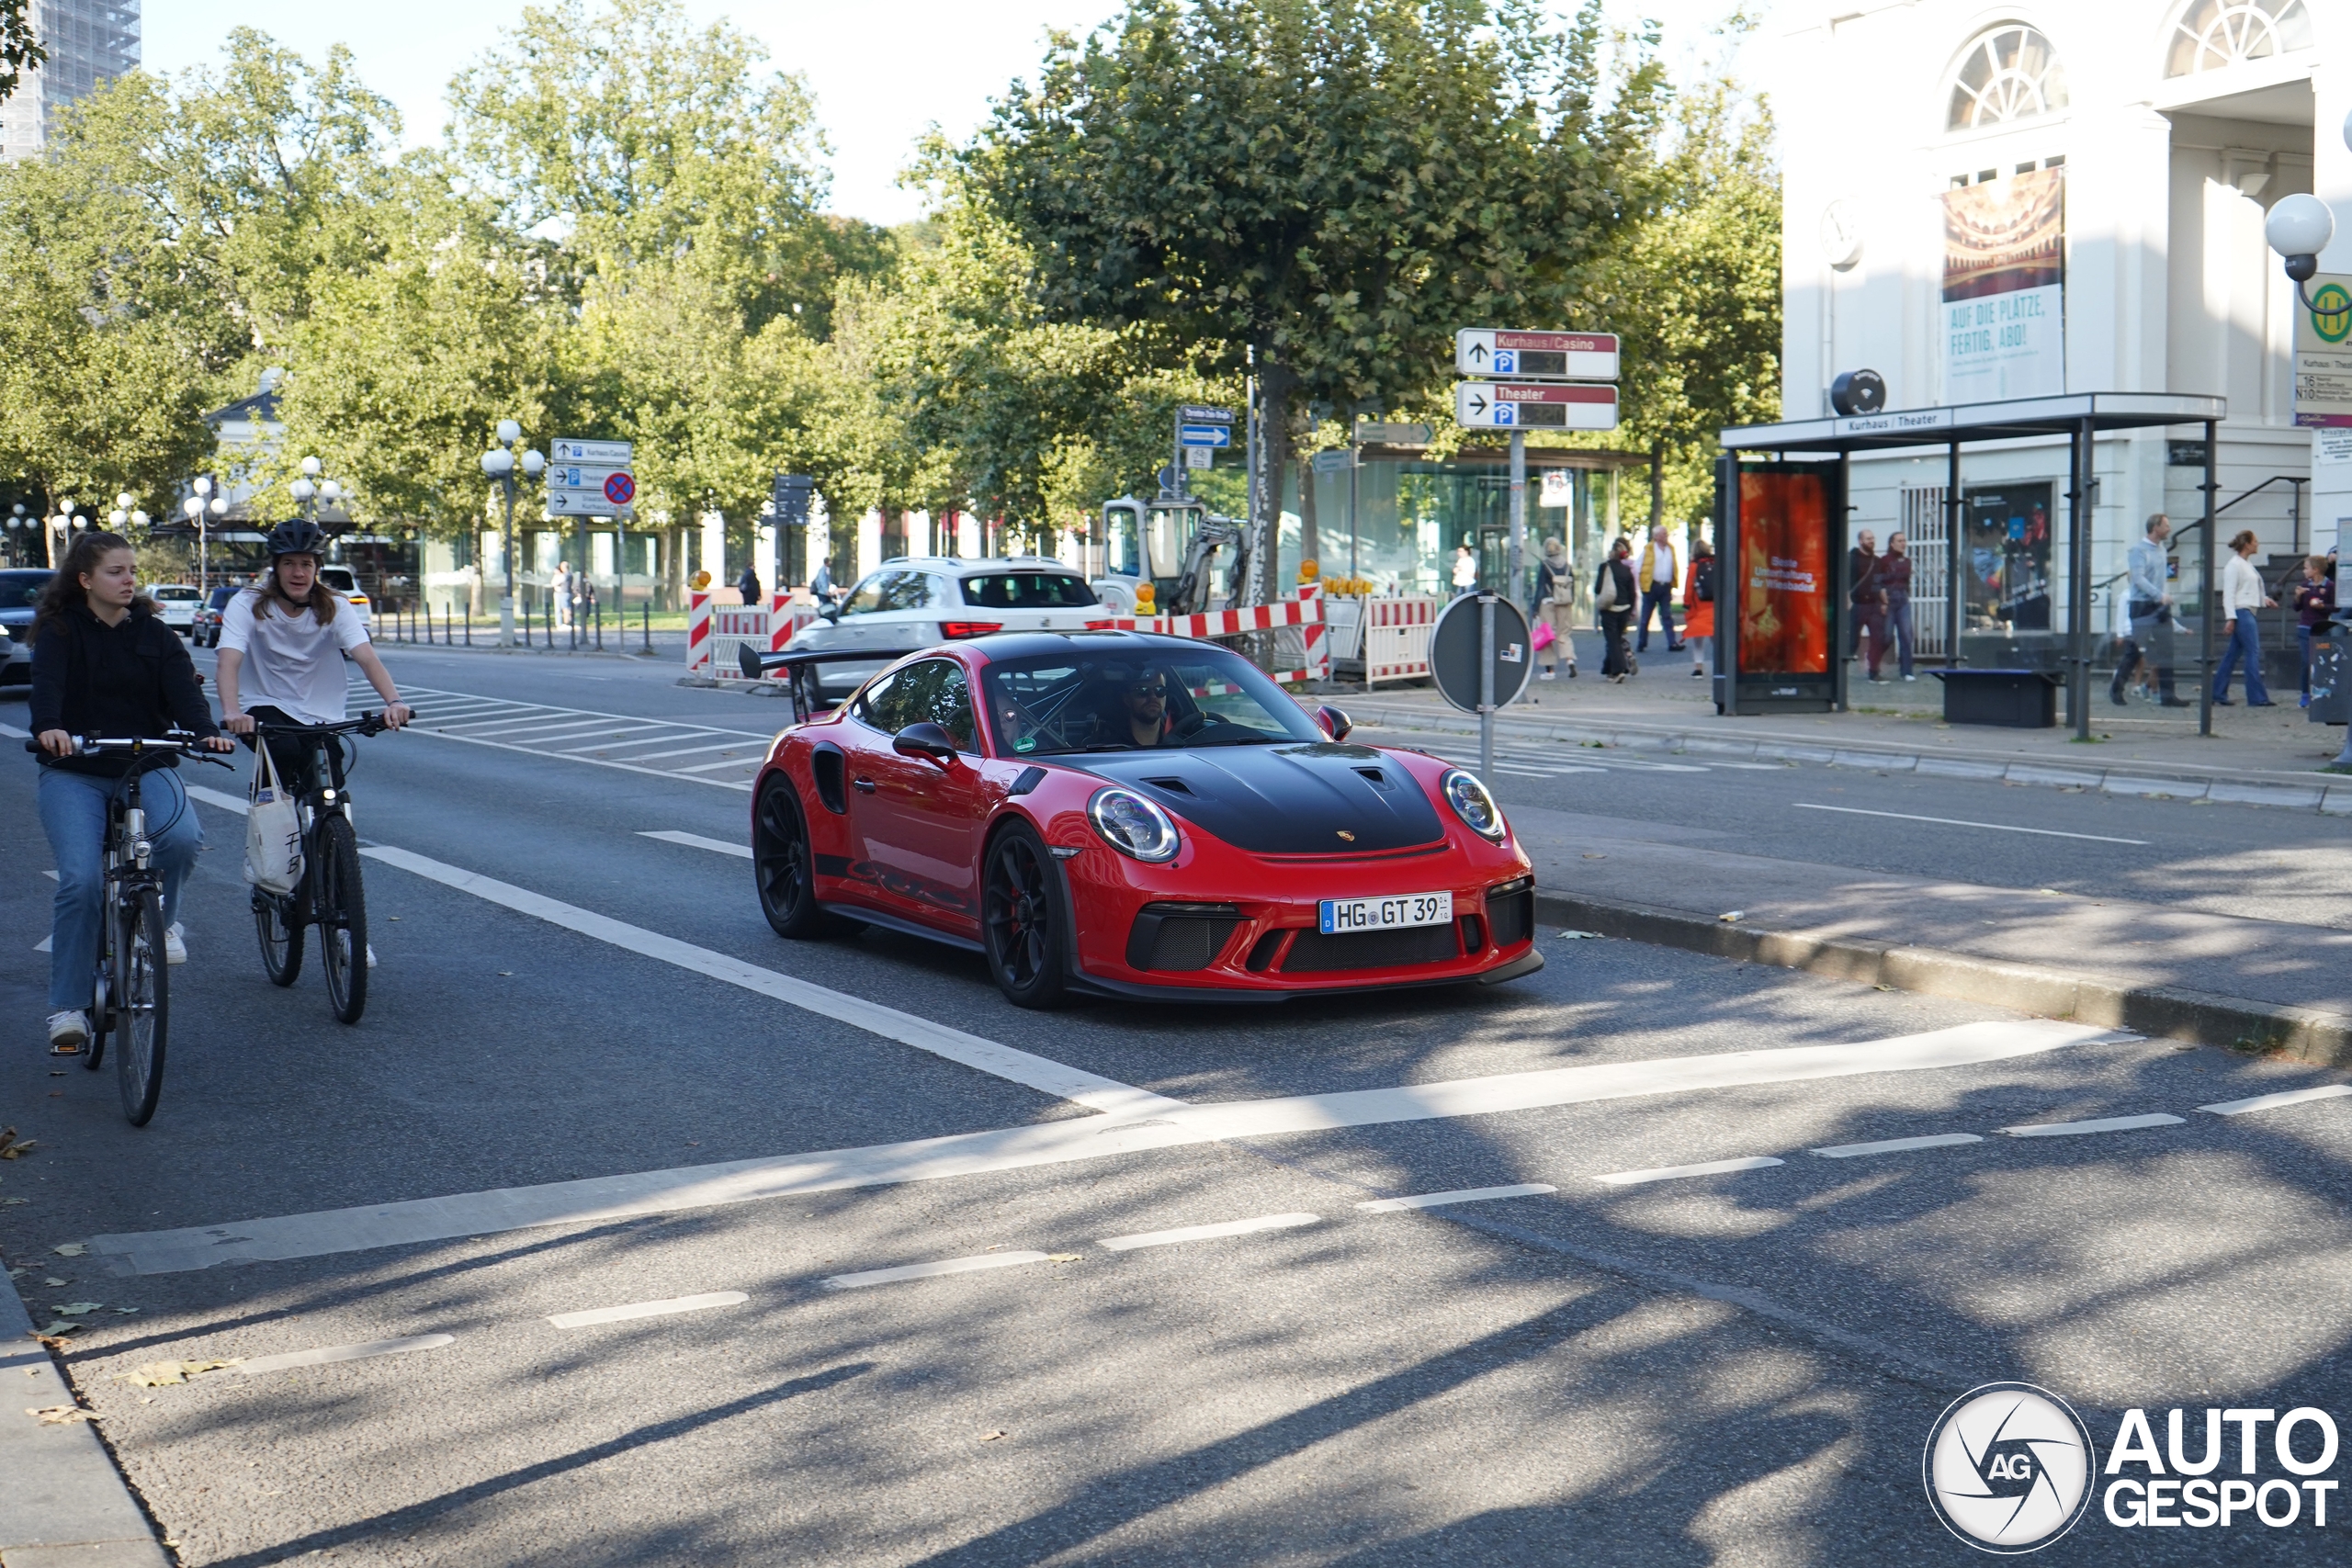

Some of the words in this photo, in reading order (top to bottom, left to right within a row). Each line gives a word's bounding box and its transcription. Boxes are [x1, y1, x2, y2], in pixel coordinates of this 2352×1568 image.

[1951, 306, 1972, 330] AUF
[1976, 301, 1996, 325] DIE
[1999, 294, 2046, 321] PLÄTZE,
[1951, 329, 1995, 356] FERTIG,
[1998, 323, 2027, 348] ABO!
[2303, 359, 2330, 367] Kurhaus
[2303, 376, 2315, 387] 16
[1498, 387, 1545, 400] Theater
[2296, 389, 2315, 400] N10
[1849, 419, 1888, 431] Kurhaus
[1898, 414, 1937, 426] Theater
[1770, 556, 1798, 568] Beste
[1754, 566, 1813, 583] Unterhaltung
[1750, 577, 1764, 588] für
[1766, 578, 1816, 592] Wiesbaden
[1337, 903, 1366, 928] HG
[1382, 899, 1408, 924] GT
[1413, 897, 1438, 921] 39
[1325, 919, 1331, 928] D
